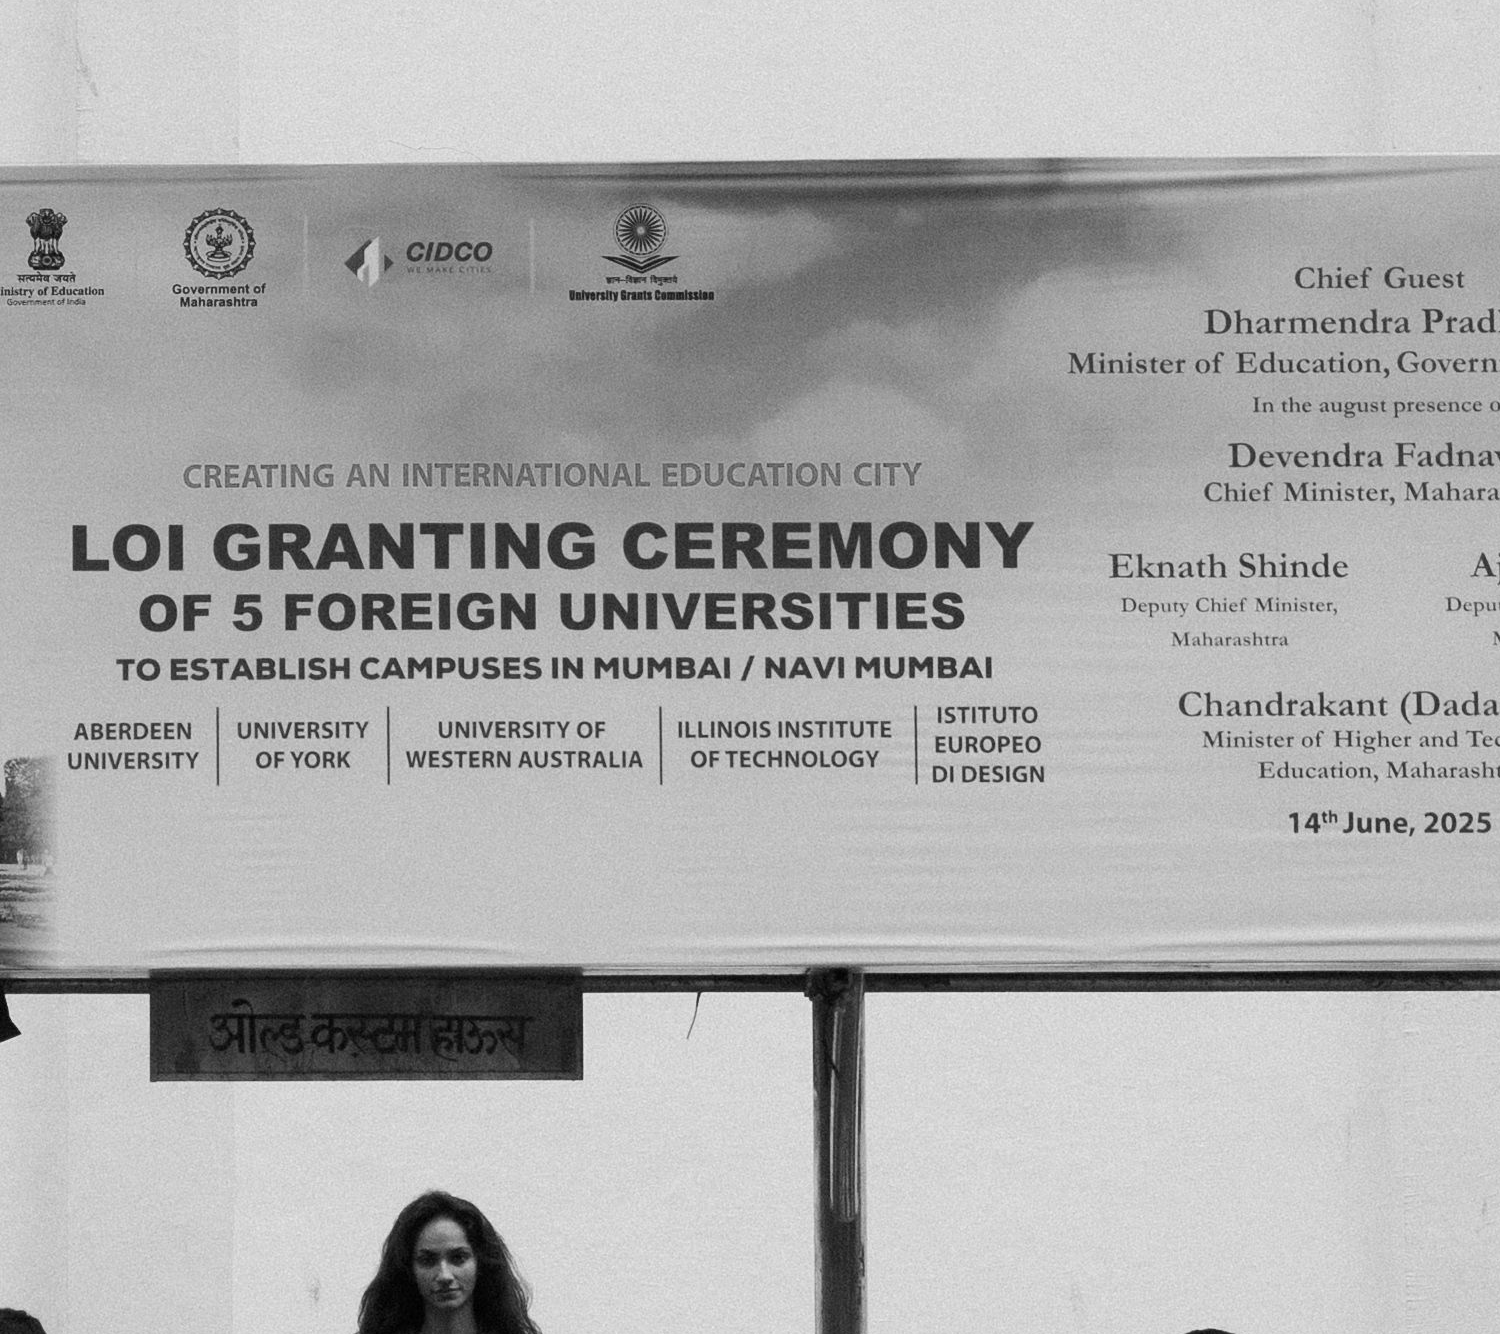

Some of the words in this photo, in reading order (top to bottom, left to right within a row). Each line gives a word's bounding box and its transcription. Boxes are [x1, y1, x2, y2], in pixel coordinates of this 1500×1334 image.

[405, 241, 493, 263] CIDCO
[16, 271, 50, 283] सत्यमेव
[53, 271, 77, 283] जयते
[406, 266, 421, 274] WE
[426, 265, 454, 274] MAKE
[458, 265, 492, 274] CITIES
[1294, 266, 1373, 290] Chief
[1383, 266, 1464, 289] Guest
[37, 286, 49, 297] of
[50, 285, 105, 296] Education
[172, 283, 250, 295] Government
[252, 282, 267, 295] of
[568, 289, 619, 302] University
[620, 289, 653, 301] Grants
[654, 289, 715, 301] Commission
[6, 296, 56, 307] Government
[56, 297, 66, 306] of
[66, 298, 87, 306] India
[179, 296, 258, 308] Maharashtra
[1205, 308, 1411, 335] Dharmendra
[1068, 351, 1187, 375] Minister
[1194, 351, 1225, 374] of
[1237, 351, 1391, 379] Education,
[1253, 396, 1275, 414] In
[1280, 396, 1312, 414] the
[1319, 400, 1387, 419] august
[1392, 400, 1483, 419] presence
[1228, 442, 1384, 469] Devendra
[183, 463, 334, 489] CREATING
[346, 462, 390, 488] AN
[402, 461, 651, 488] INTERNATIONAL
[661, 461, 842, 488] EDUCATION
[853, 462, 922, 487] CITY
[1203, 481, 1274, 503] Chief
[1284, 481, 1396, 505] Minister,
[72, 523, 184, 572] LOI
[213, 521, 596, 572] GRANTING
[622, 520, 1034, 570] CEREMONY
[1110, 553, 1227, 579] Eknath
[1238, 552, 1349, 579] Shinde
[139, 593, 212, 633] OF
[232, 593, 263, 632] 5
[284, 592, 537, 632] FOREIGN
[559, 591, 965, 631] UNIVERSITIES
[1121, 597, 1187, 618] Deputy
[1194, 597, 1248, 614] Chief
[1255, 596, 1338, 615] Minister,
[1172, 631, 1289, 647] Maharashtra
[115, 657, 161, 682] TO
[169, 656, 351, 682] ESTABLISH
[359, 656, 543, 681] CAMPUSES
[551, 656, 584, 680] IN
[593, 656, 731, 680] MUMBAI
[740, 655, 755, 682] /
[764, 656, 845, 680] NAVI
[855, 656, 993, 680] MUMBAI
[1178, 691, 1387, 717] Chandrakant
[936, 705, 1039, 725] ISTITUTO
[73, 721, 192, 741] ABERDEEN
[236, 720, 369, 740] UNIVERSITY
[437, 720, 570, 740] UNIVERSITY
[576, 720, 606, 740] OF
[677, 720, 772, 739] ILLINOIS
[777, 720, 892, 739] INSTITUTE
[934, 735, 1042, 754] EUROPEO
[1203, 730, 1295, 749] Minister
[1300, 730, 1325, 748] of
[1334, 729, 1412, 754] Higher
[1419, 729, 1459, 748] and
[67, 751, 199, 771] UNIVERSITY
[255, 750, 285, 770] OF
[290, 750, 351, 770] YORK
[405, 749, 512, 769] WESTERN
[517, 750, 644, 769] AUSTRALIA
[690, 749, 720, 769] OF
[725, 749, 879, 769] TECHNOLOGY
[931, 764, 955, 784] DI
[961, 764, 1045, 784] DESIGN
[1259, 760, 1379, 783] Education,
[1288, 810, 1338, 834] 14th
[1342, 811, 1415, 837] June,
[1424, 811, 1492, 834] 2025
